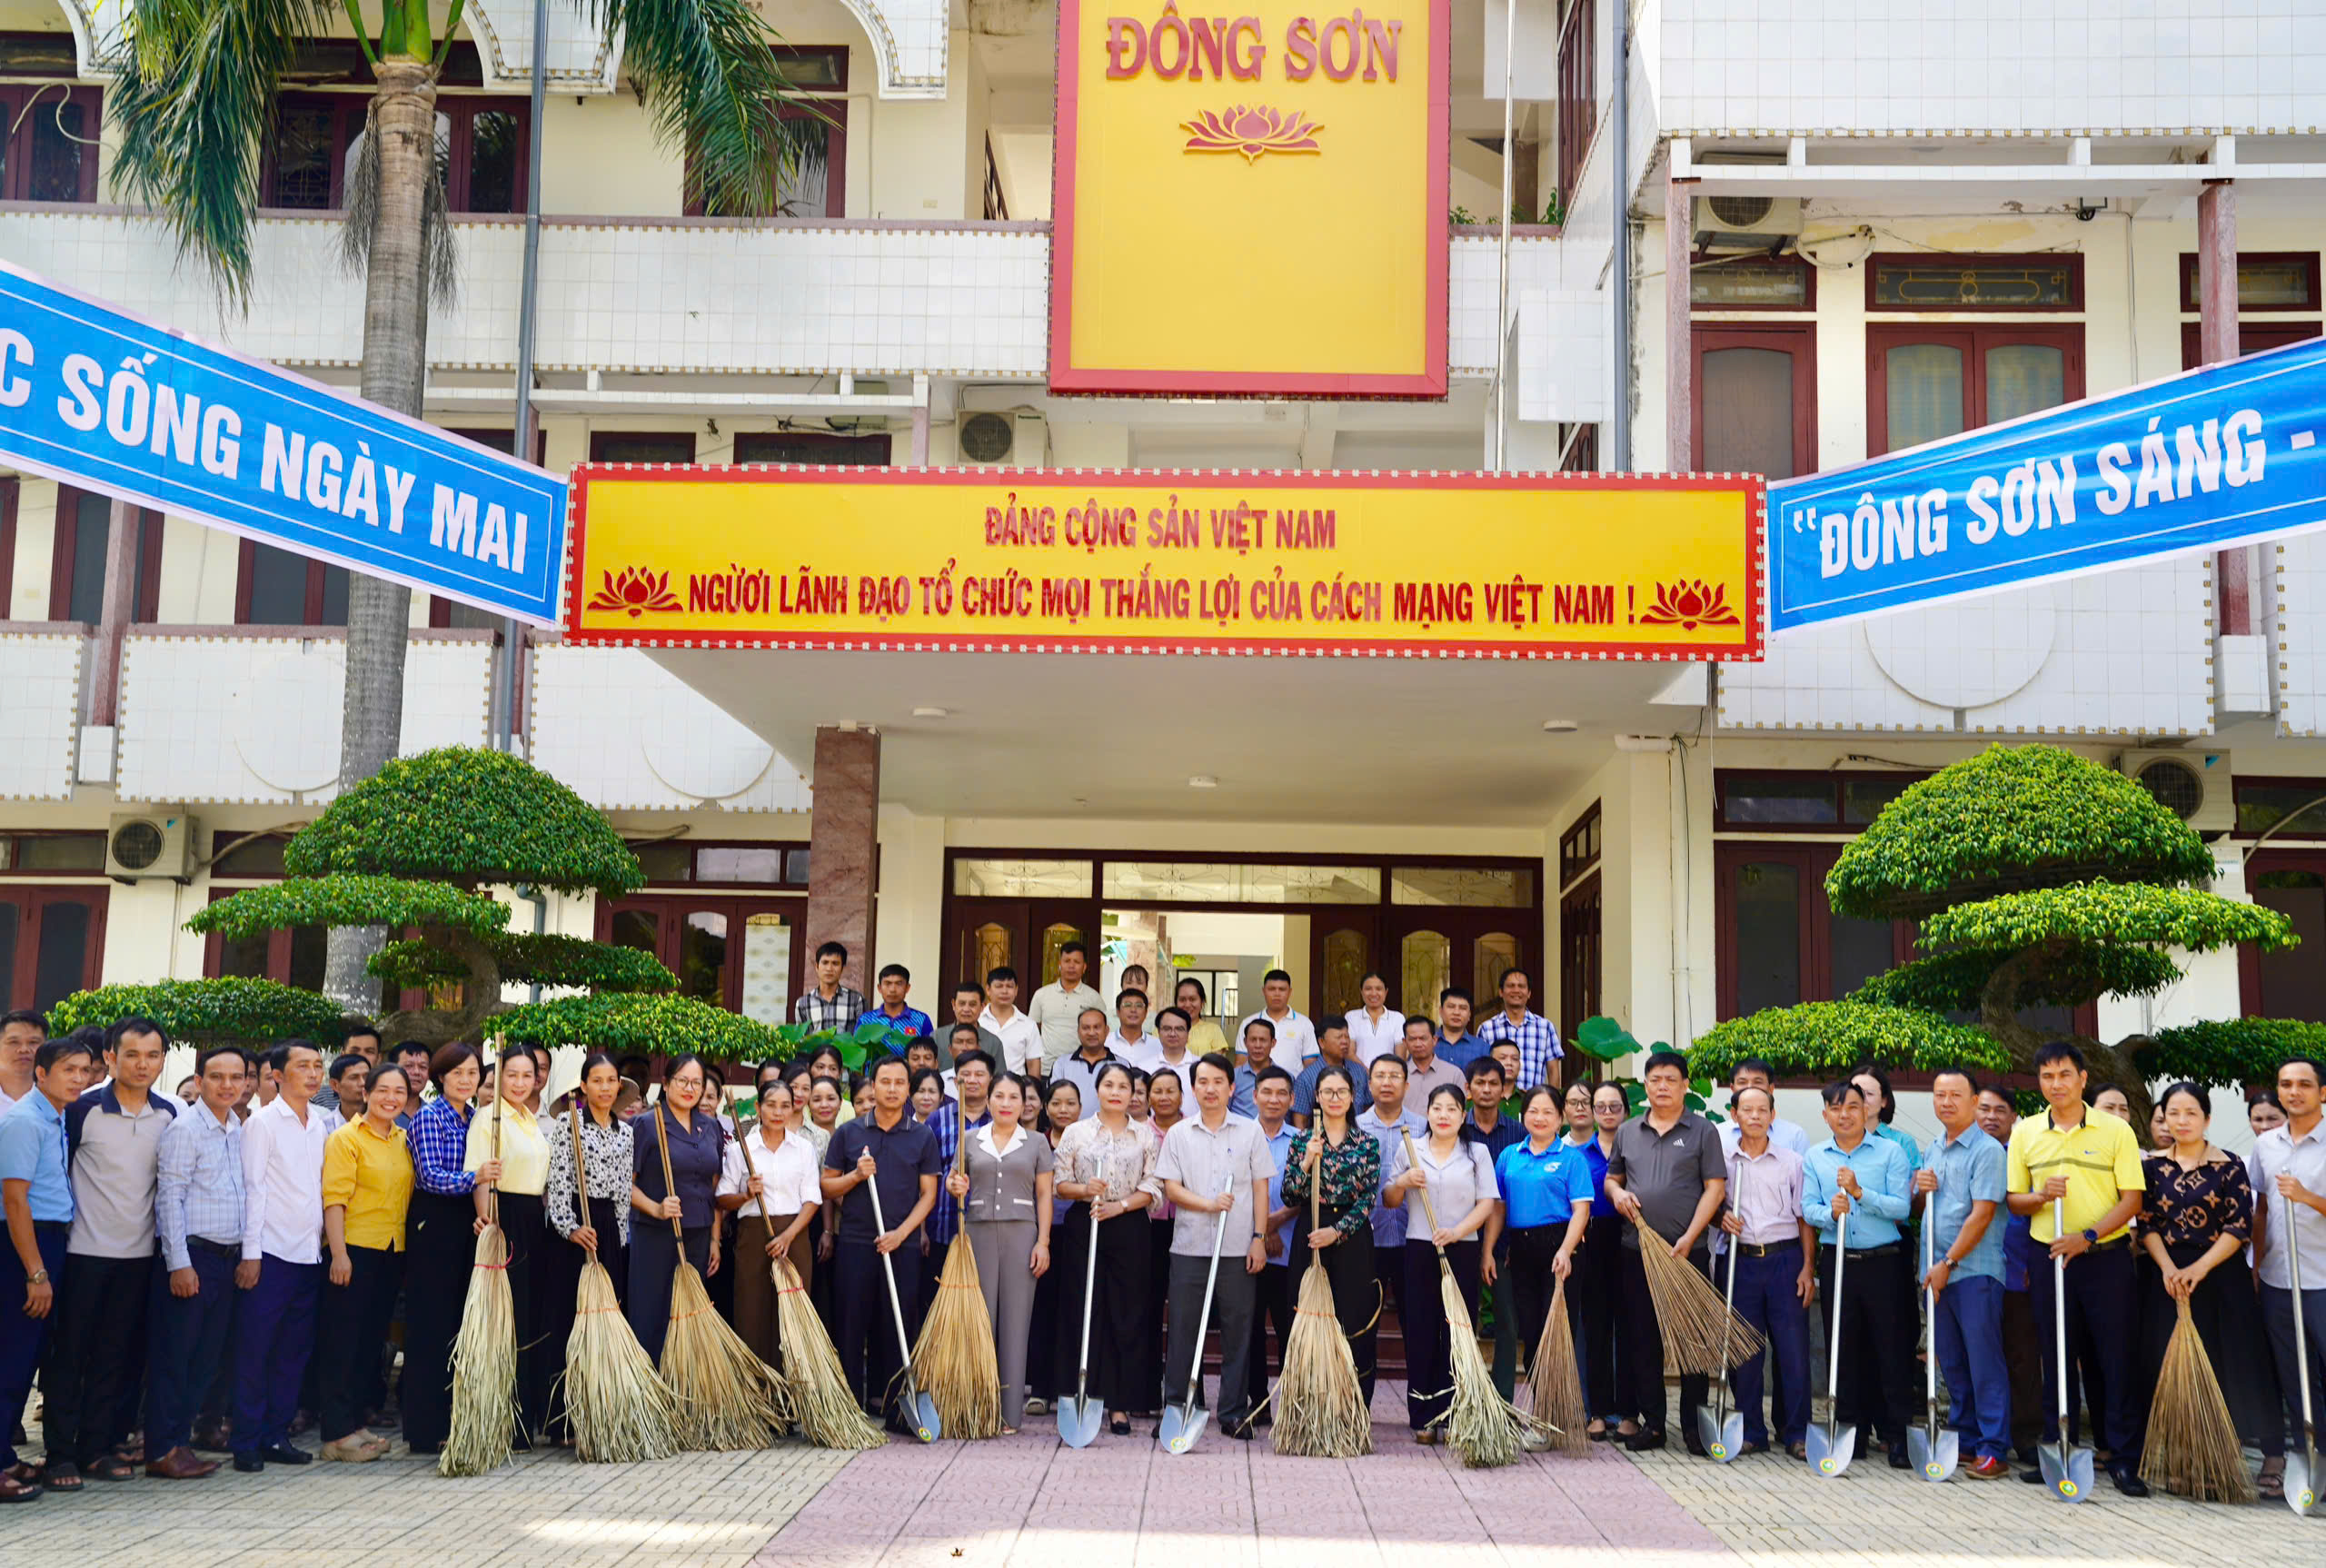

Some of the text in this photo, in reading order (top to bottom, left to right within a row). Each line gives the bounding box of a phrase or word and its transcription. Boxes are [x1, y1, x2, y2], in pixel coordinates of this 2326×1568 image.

[1106, 0, 1404, 82] ĐÔNG SƠN
[57, 352, 242, 481] SỐNG
[260, 422, 416, 534] NGÀY
[429, 482, 529, 574] MAI
[1965, 456, 2077, 545] SƠN
[2094, 408, 2267, 515] SÁNG
[984, 491, 1336, 555] ĐẢNG CỘNG SẢN VIỆT NAM
[779, 564, 848, 615] LÃNH
[859, 575, 910, 622] ĐẠO
[919, 557, 956, 617] TỔ
[961, 567, 1033, 618] CHỨC
[1041, 578, 1090, 624] MỌI
[1099, 562, 1190, 619] THẮNG
[1199, 573, 1240, 626] LỢI
[1250, 565, 1302, 620] CỦA
[1310, 571, 1381, 621] CÁCH
[1394, 581, 1473, 629] MẠNG
[1484, 574, 1543, 630] VIỆT
[1554, 584, 1614, 625] NAM
[1627, 584, 1635, 625] !
